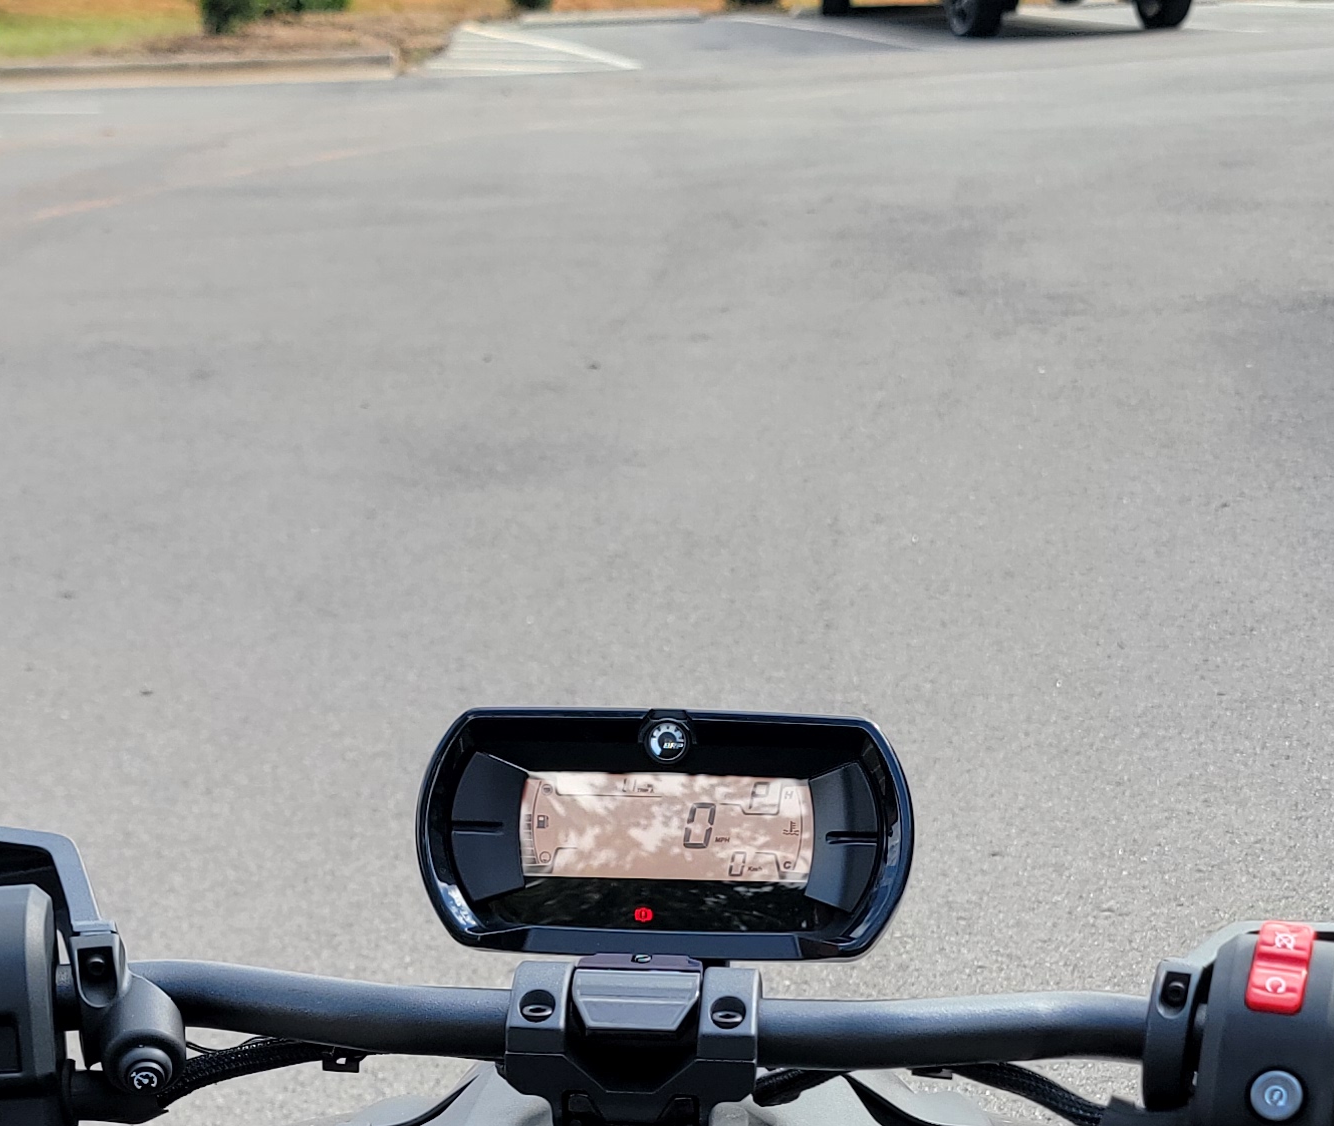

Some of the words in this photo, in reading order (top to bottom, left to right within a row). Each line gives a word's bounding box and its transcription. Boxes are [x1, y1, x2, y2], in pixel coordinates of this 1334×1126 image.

[683, 802, 716, 849] 0
[728, 851, 747, 877] 0
[783, 860, 792, 870] C
